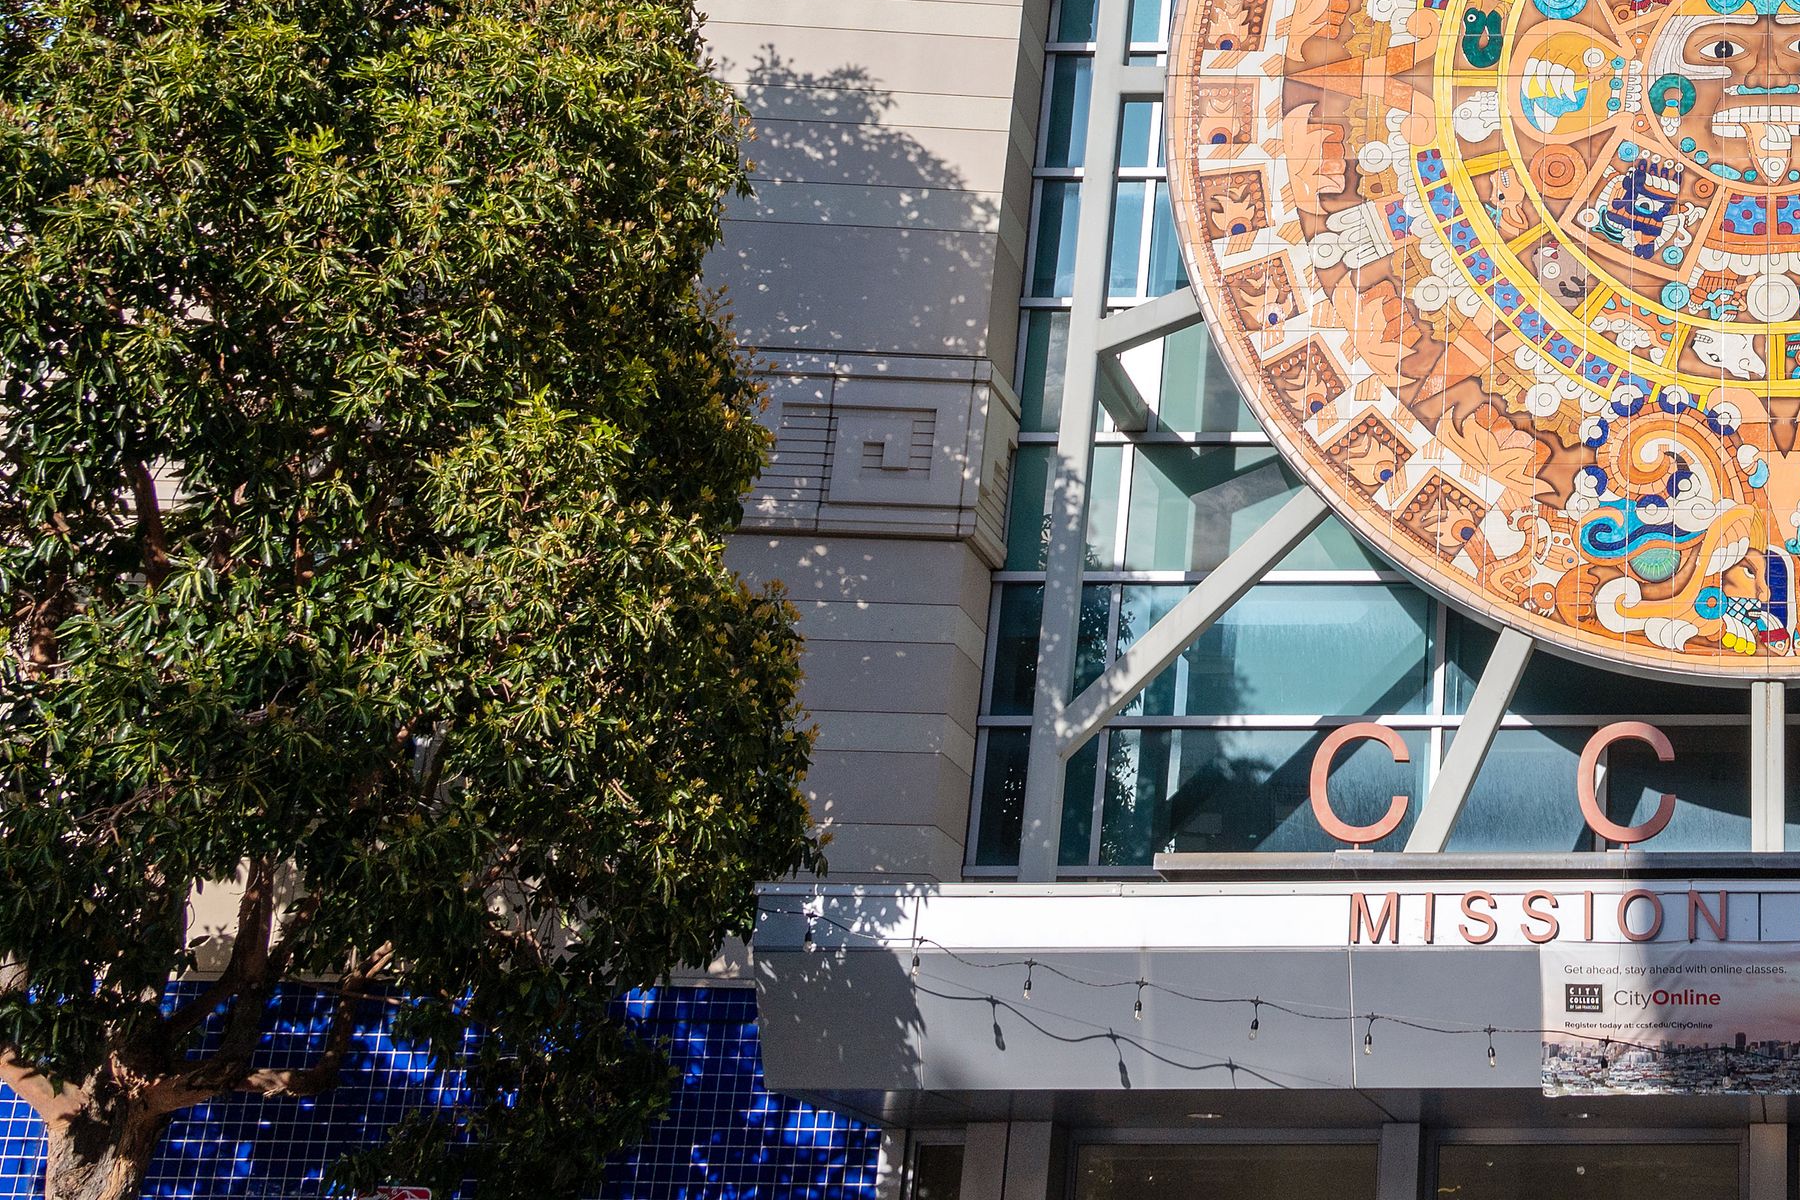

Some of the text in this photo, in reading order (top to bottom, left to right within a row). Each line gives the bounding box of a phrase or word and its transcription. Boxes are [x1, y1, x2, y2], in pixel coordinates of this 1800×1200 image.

[1350, 888, 1729, 944] MISSION
[1564, 964, 1787, 977] Get ahead, stay ahead with online classes.
[1569, 987, 1599, 995] CITY
[1613, 989, 1721, 1010] CityOnline
[1564, 1021, 1597, 1030] Register
[1599, 1021, 1622, 1030] today
[1635, 1021, 1713, 1030] ccsf.edu/CityOnline
